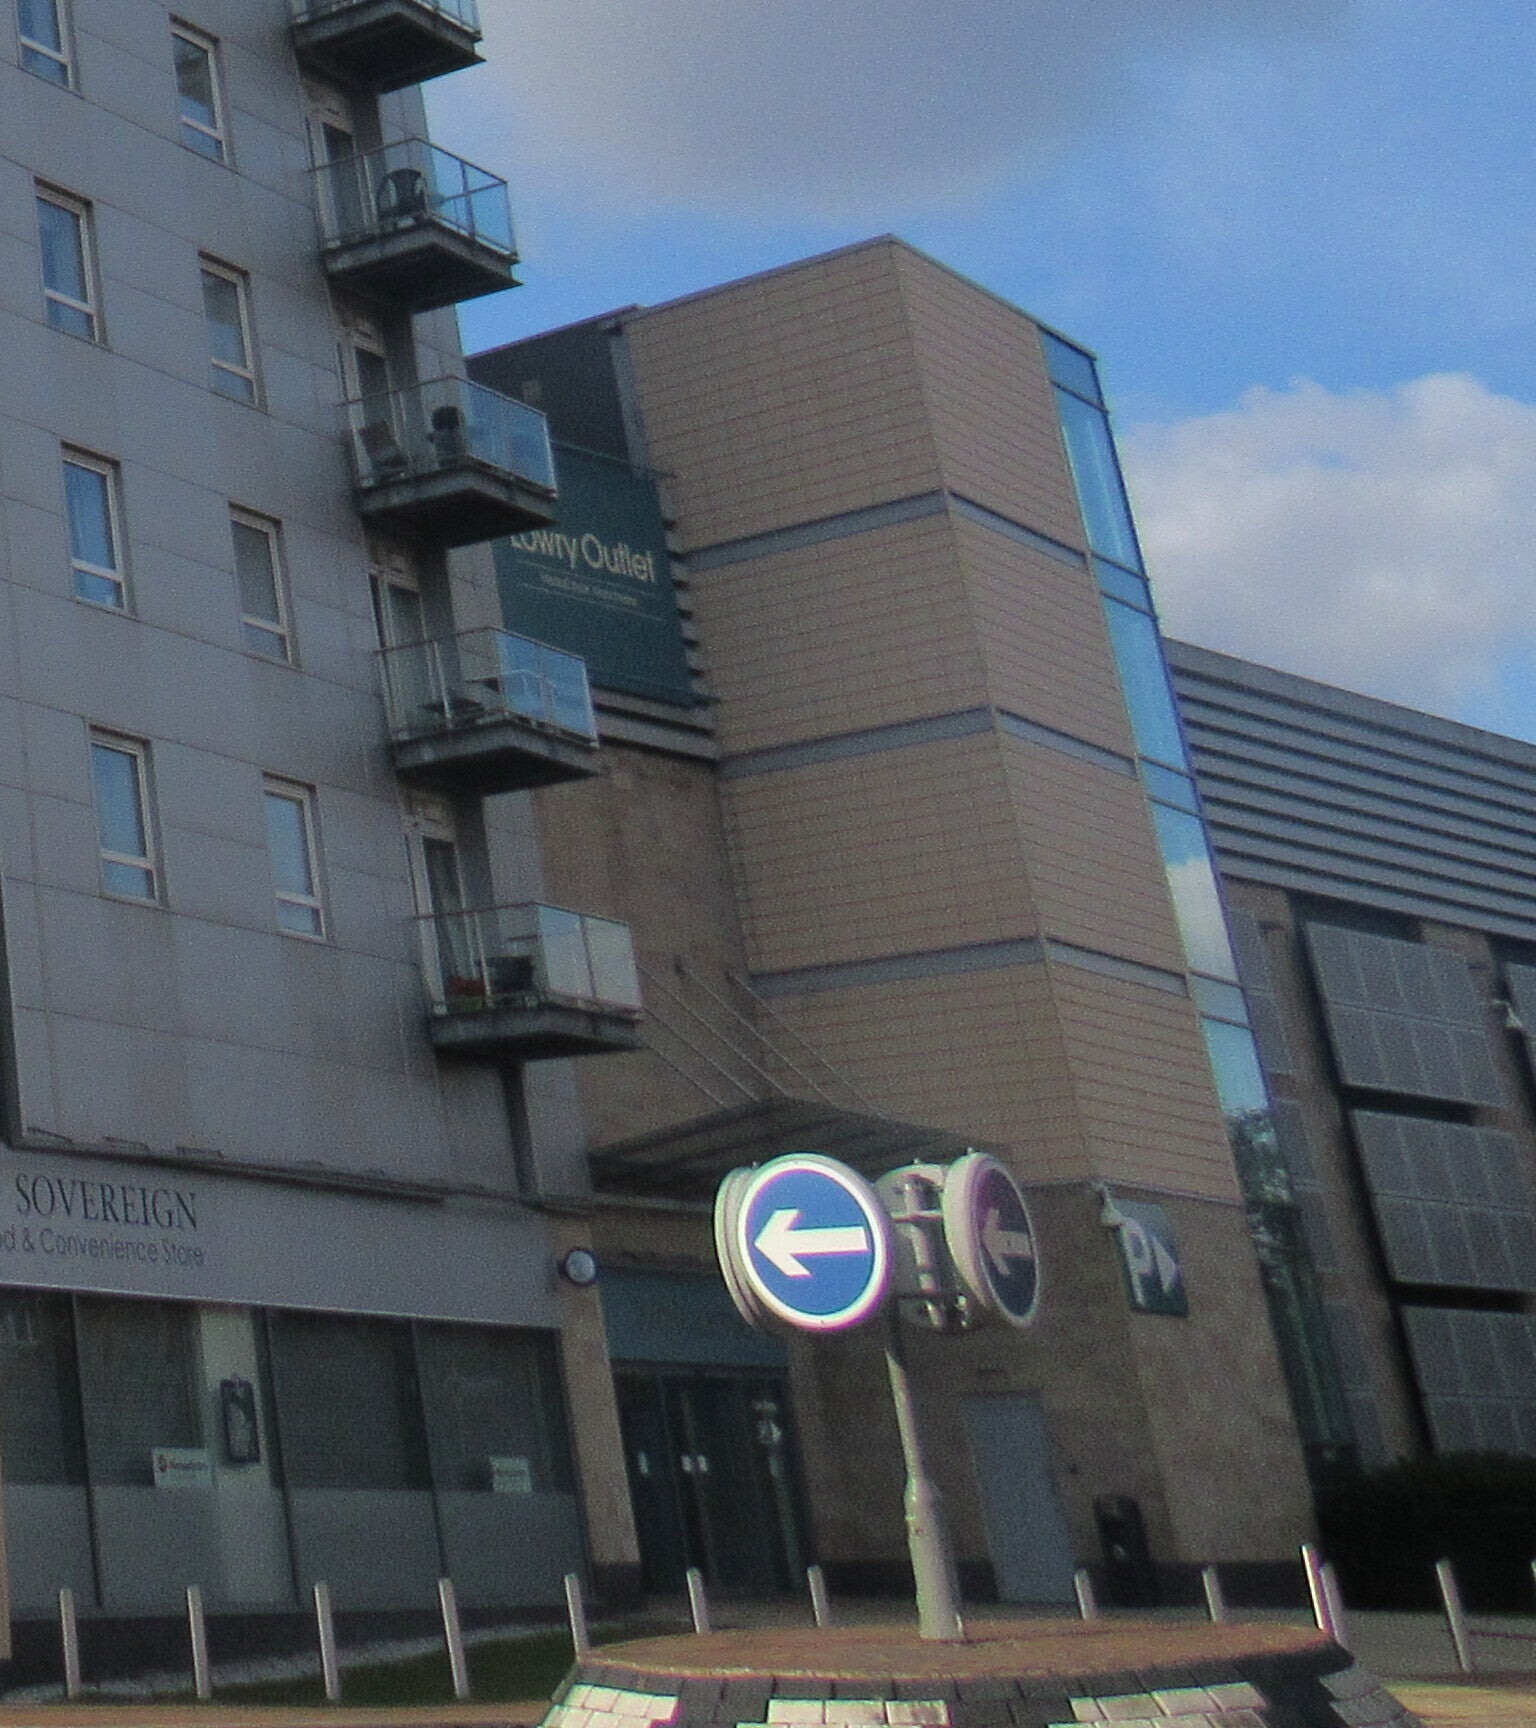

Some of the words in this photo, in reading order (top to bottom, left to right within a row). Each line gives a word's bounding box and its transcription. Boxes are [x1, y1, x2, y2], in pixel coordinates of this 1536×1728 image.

[581, 532, 655, 583] Outlet
[15, 1173, 198, 1231] SOVEREIGN
[22, 1227, 34, 1252] &
[40, 1228, 159, 1263] Convenience
[161, 1238, 205, 1267] Store
[1120, 1217, 1151, 1307] P
